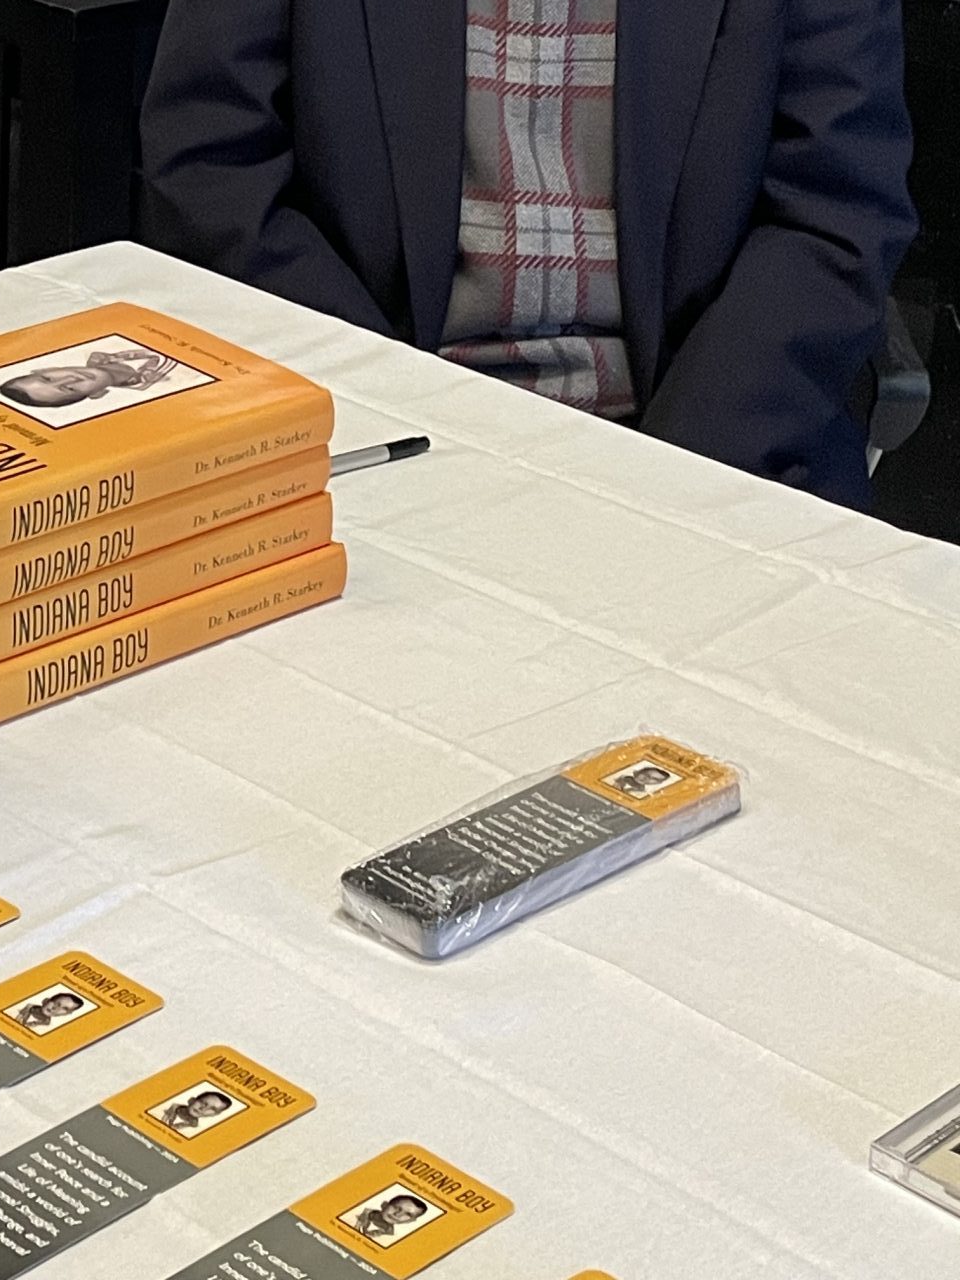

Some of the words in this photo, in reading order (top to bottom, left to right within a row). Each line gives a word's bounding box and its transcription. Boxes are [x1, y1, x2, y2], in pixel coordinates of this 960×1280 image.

[194, 460, 211, 475] Dr.
[213, 444, 257, 469] Kenneth
[259, 439, 272, 454] R.
[273, 428, 312, 450] Starkey
[11, 485, 90, 541] INDIANA
[96, 470, 134, 514] BOY
[192, 514, 208, 528] Dr.
[211, 497, 254, 521] Kenneth
[256, 492, 266, 506] R.
[270, 482, 307, 500] Starkey
[11, 541, 91, 598] INDIANA
[94, 525, 135, 570] BOY
[193, 561, 208, 576] Dr.
[211, 543, 255, 568] Kenneth
[257, 539, 269, 554] R.
[271, 528, 310, 548] Starkey
[12, 588, 89, 647] INDIANA
[97, 573, 133, 618] BOY
[207, 615, 223, 630] Dr.
[227, 596, 270, 623] Kenneth
[272, 592, 284, 606] R.
[286, 580, 323, 601] Starkey
[27, 645, 105, 704] INDIANA
[112, 627, 148, 674] BOY
[61, 959, 118, 993] INDIANA
[109, 988, 145, 1008] BOY
[206, 1055, 267, 1092] INDIANA
[258, 1086, 297, 1108] BOY
[395, 1154, 462, 1195] INDIANA
[454, 1189, 495, 1213] BOY
[218, 1262, 253, 1280] Inne
[248, 1239, 269, 1256] The
[267, 1255, 309, 1280] candid
